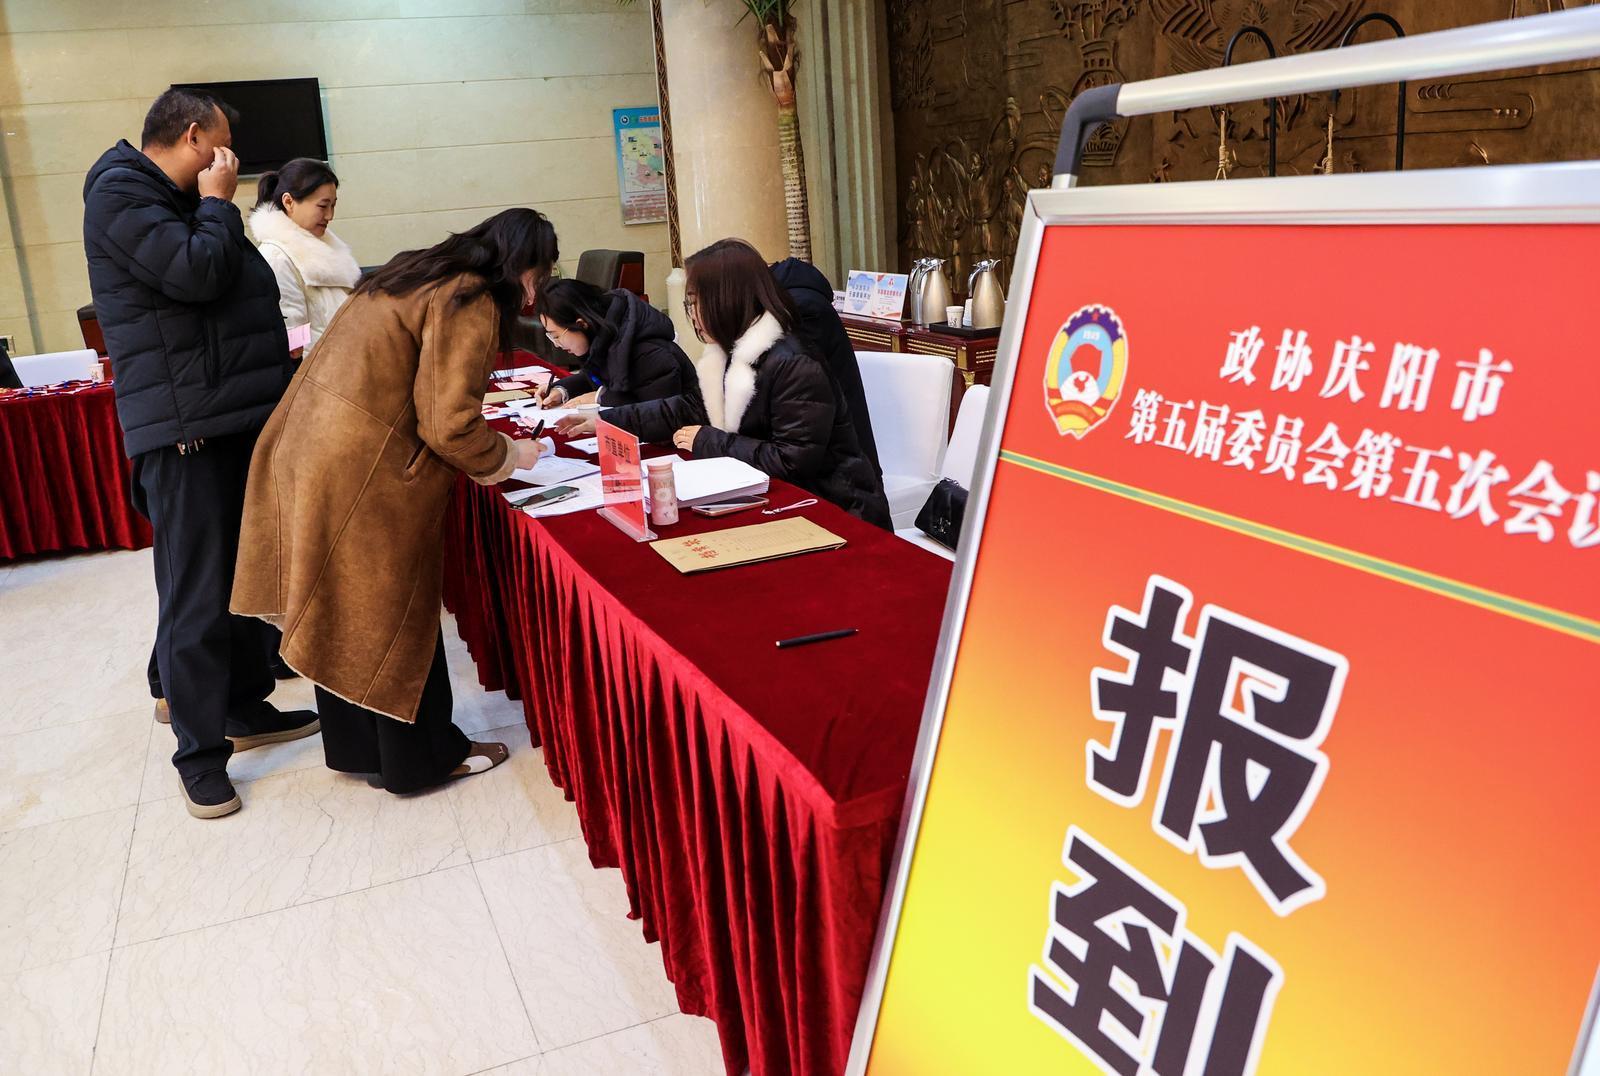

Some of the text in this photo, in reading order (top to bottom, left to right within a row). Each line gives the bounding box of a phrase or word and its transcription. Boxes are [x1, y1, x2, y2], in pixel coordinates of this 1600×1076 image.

[1219, 325, 1514, 422] 政协庆阳市
[1027, 573, 1350, 1076] 报到
